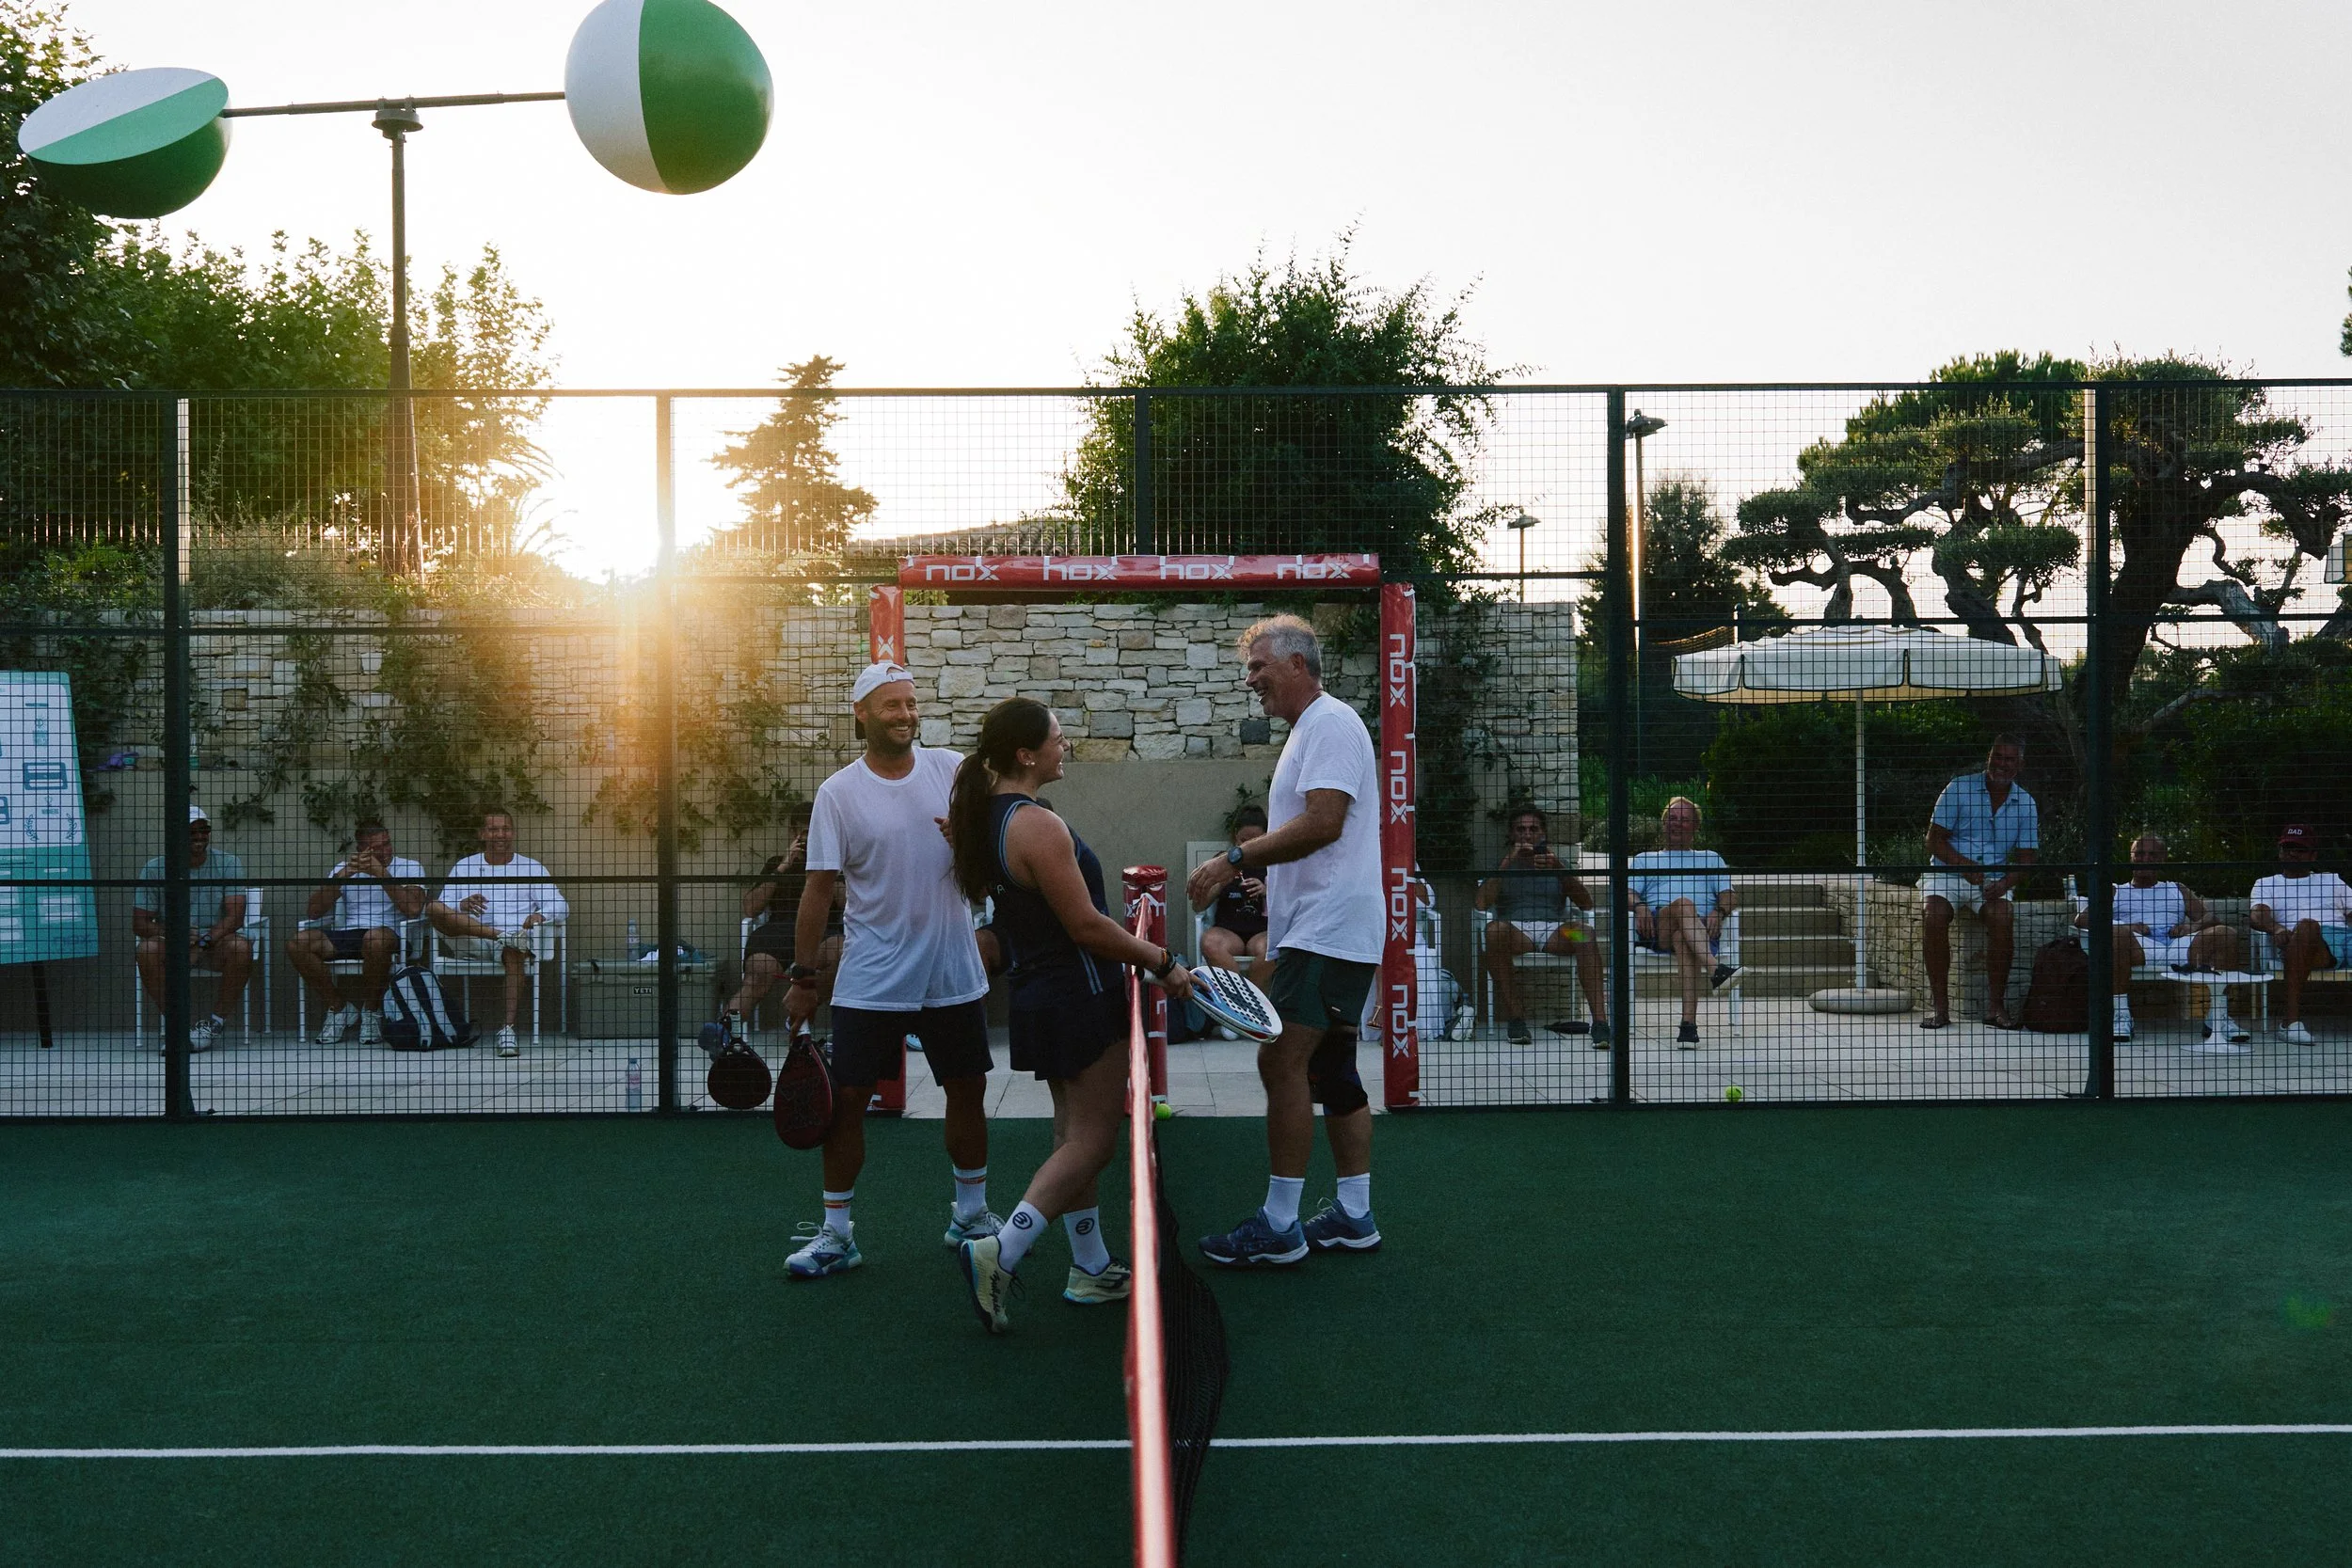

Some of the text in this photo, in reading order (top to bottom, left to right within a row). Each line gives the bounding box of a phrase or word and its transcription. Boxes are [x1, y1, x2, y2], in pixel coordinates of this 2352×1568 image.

[926, 564, 999, 580] nox
[1277, 562, 1351, 579] nox
[1390, 633, 1408, 1058] nox nox nox nox
